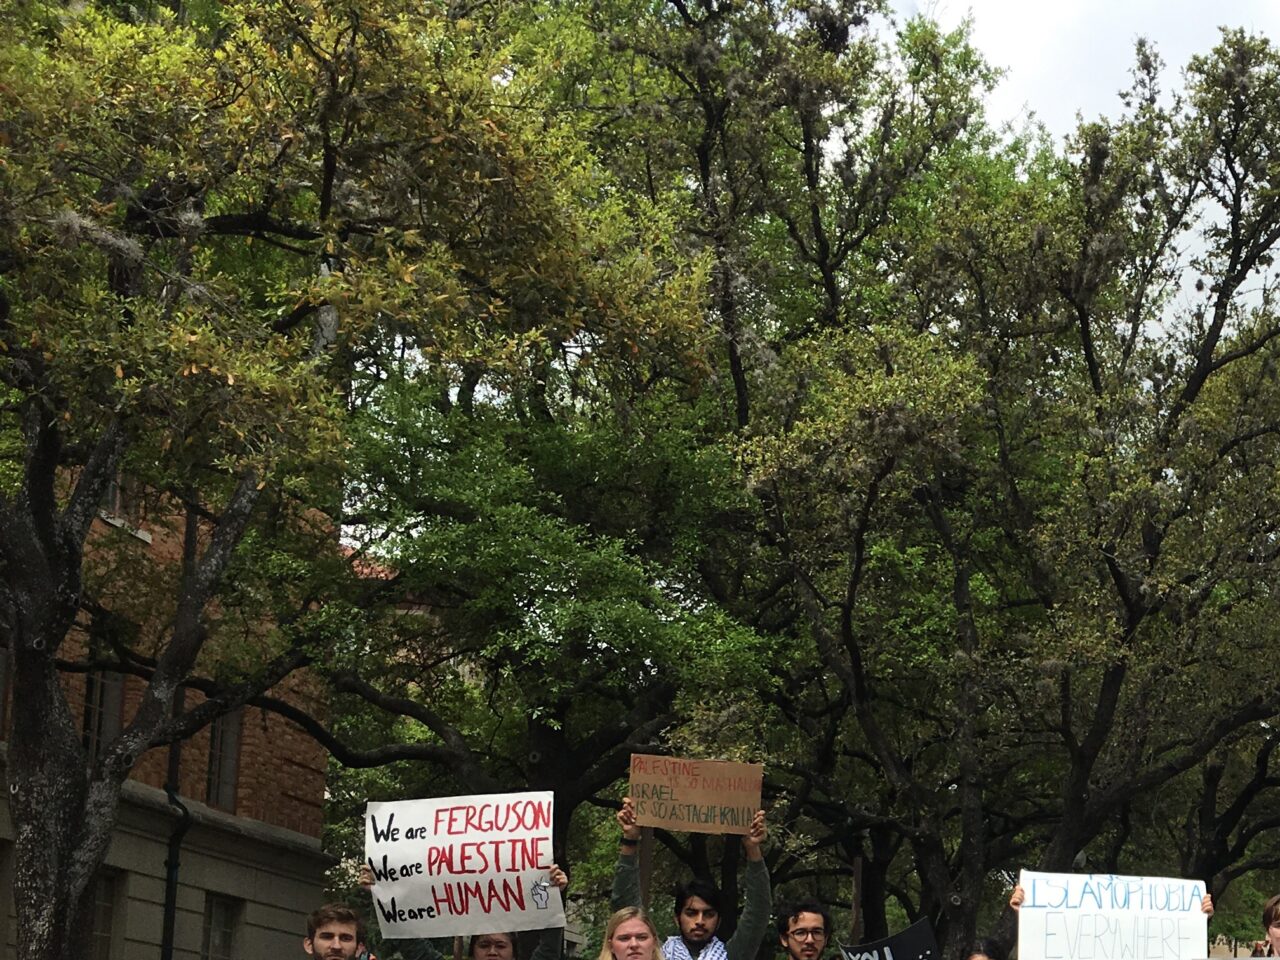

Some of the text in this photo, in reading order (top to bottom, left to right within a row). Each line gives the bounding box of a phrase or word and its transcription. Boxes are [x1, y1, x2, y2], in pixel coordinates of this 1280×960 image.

[632, 757, 700, 776] PALESTINE
[631, 783, 680, 800] ISRAEL
[636, 801, 647, 816] IS
[371, 800, 552, 843] We are FERGUSON
[368, 836, 552, 882] We are PALESTINE
[377, 875, 527, 923] We are HUMAN
[1021, 878, 1204, 912] ISLAMOPHOBIA
